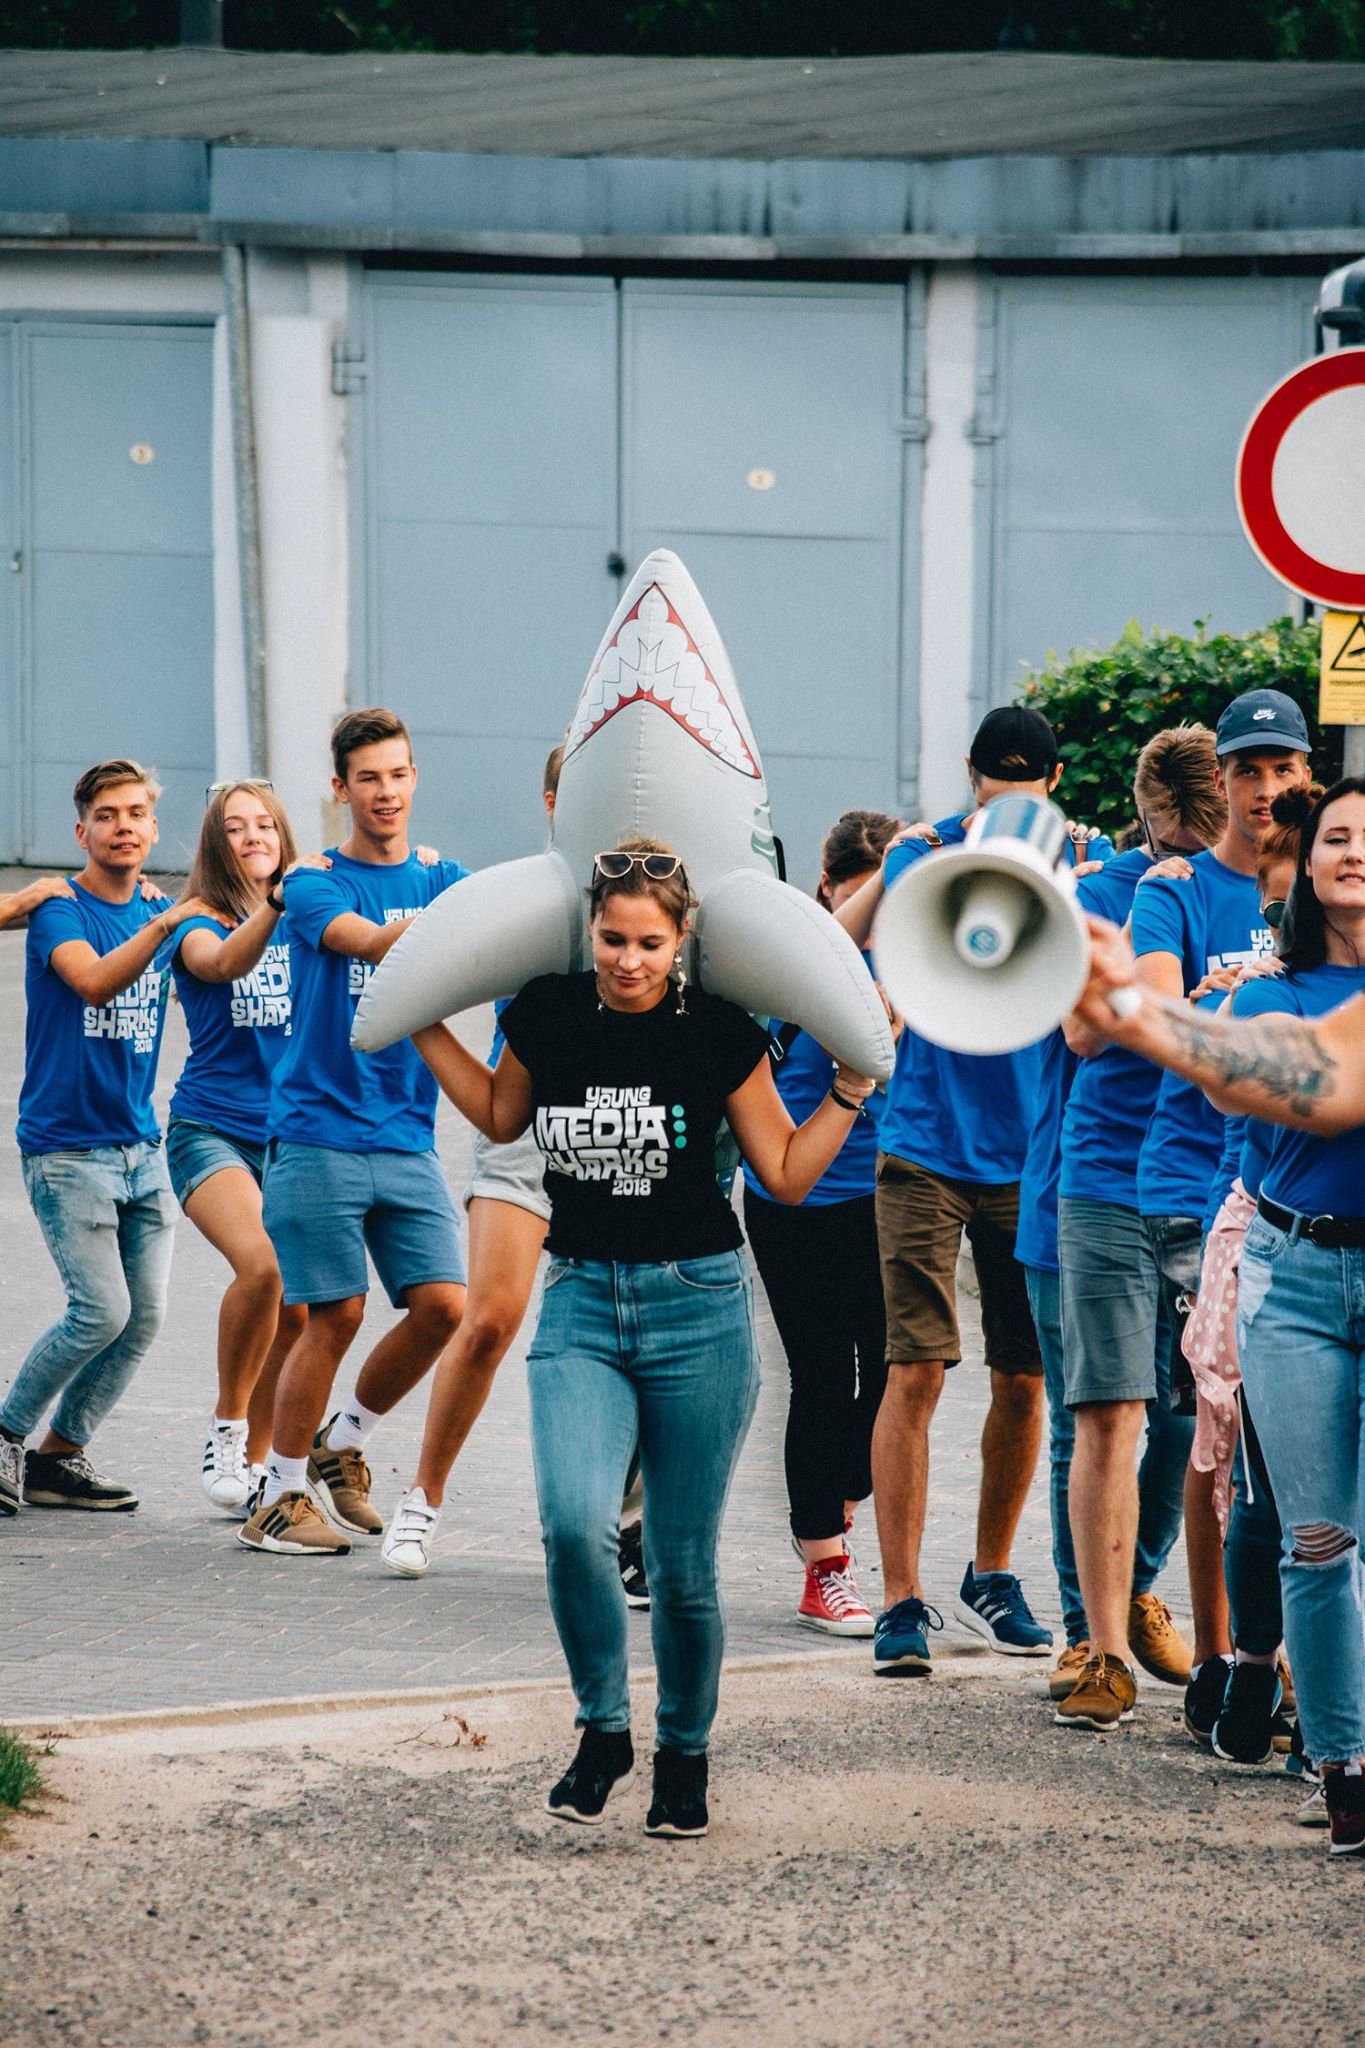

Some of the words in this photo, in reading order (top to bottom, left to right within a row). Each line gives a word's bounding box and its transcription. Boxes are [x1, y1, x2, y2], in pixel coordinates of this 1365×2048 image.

[83, 1006, 159, 1040] SHARKS
[134, 1038, 153, 1054] 2018
[585, 1085, 652, 1109] YOUNG
[535, 1105, 670, 1150] MEDIA
[612, 1178, 651, 1197] 2018
